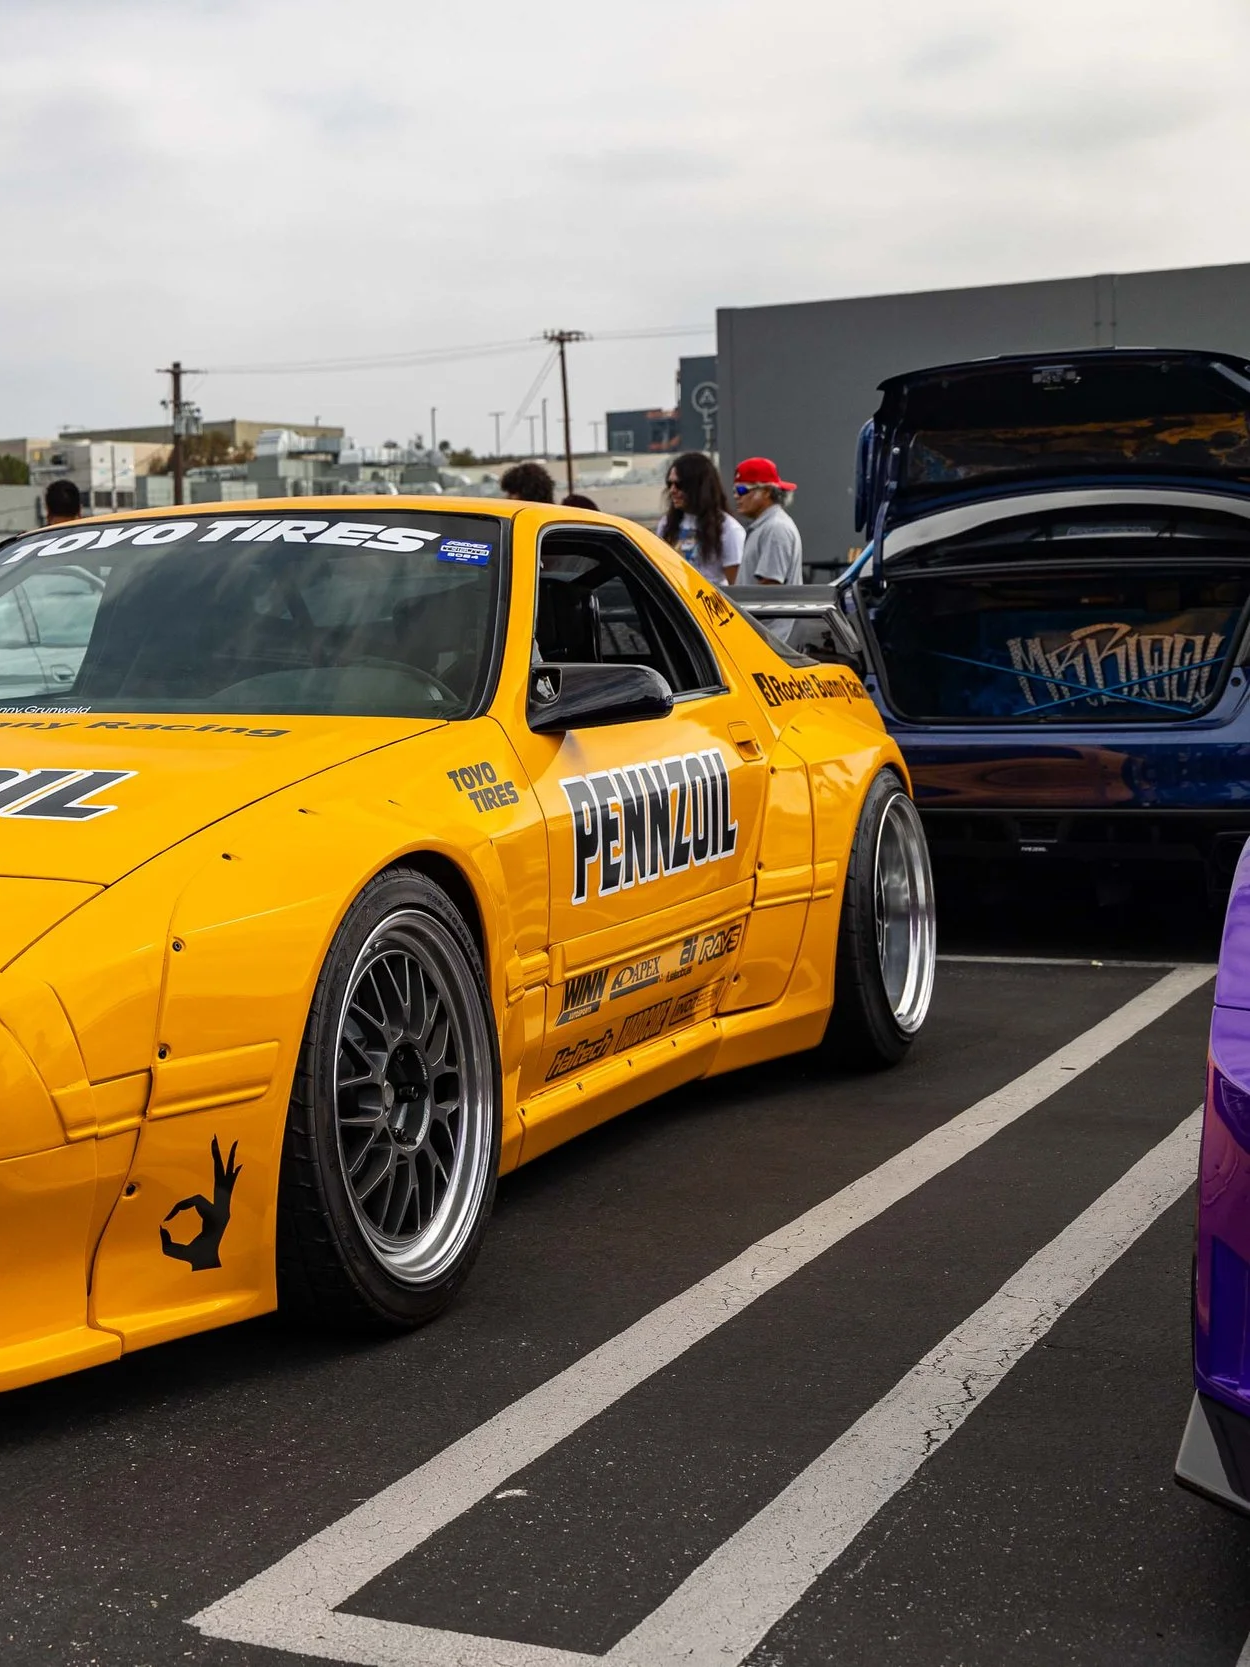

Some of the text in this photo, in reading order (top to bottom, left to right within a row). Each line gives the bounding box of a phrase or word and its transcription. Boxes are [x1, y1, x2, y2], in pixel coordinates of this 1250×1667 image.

[1, 519, 442, 565] TOYO TIRES
[769, 674, 819, 701] Rocket
[84, 720, 291, 737] Racing
[447, 761, 497, 792] TOYO
[467, 780, 519, 813] TIRES
[559, 748, 738, 905] PENNZOIL
[698, 922, 743, 965] RAYS
[563, 967, 610, 1012] WINN
